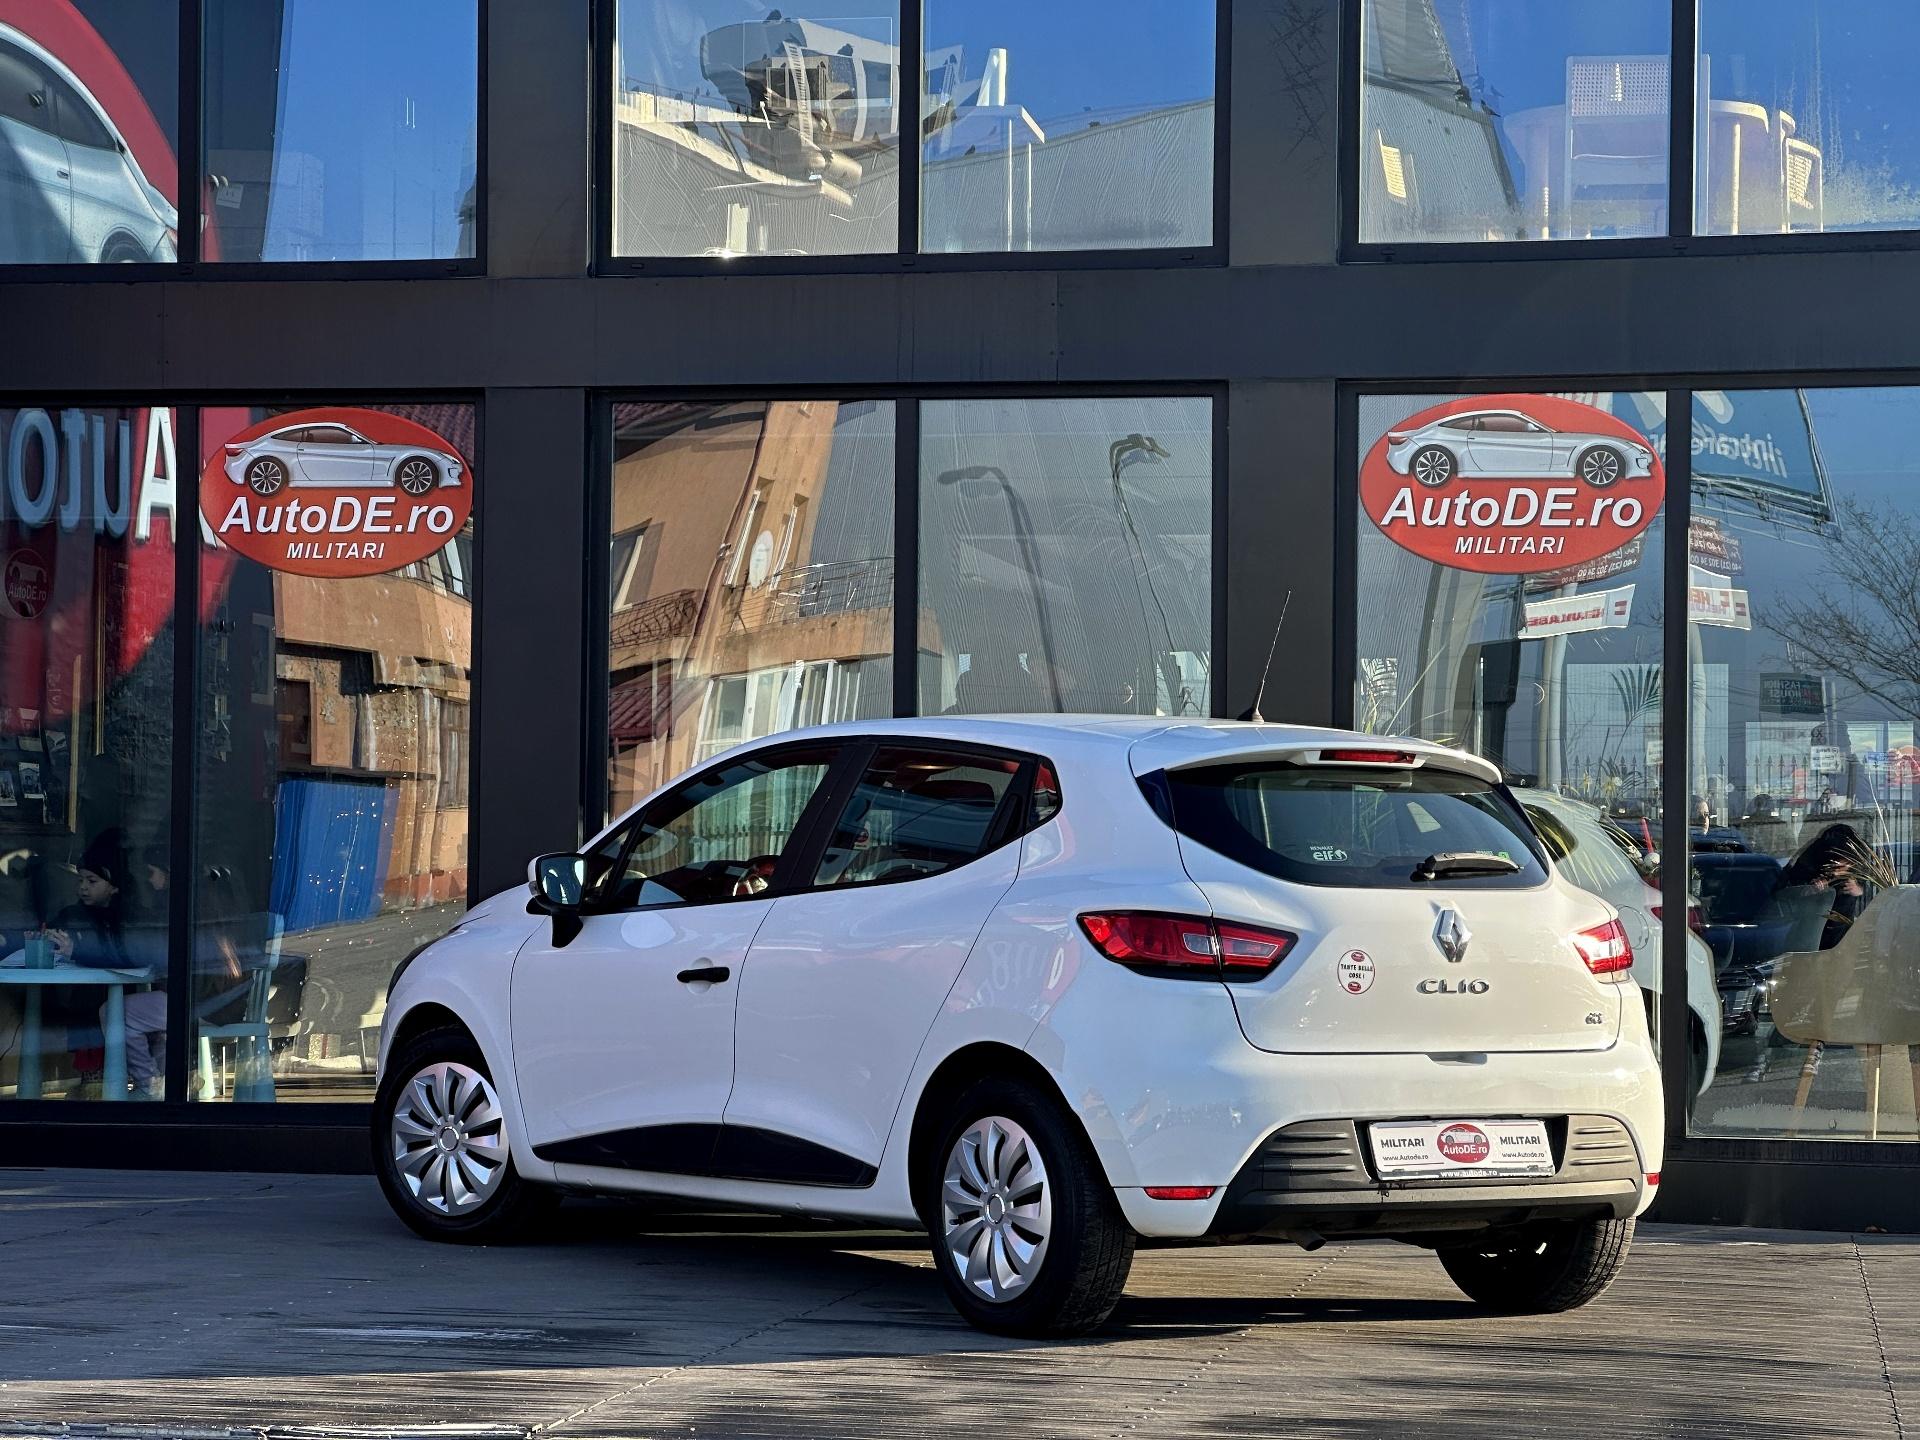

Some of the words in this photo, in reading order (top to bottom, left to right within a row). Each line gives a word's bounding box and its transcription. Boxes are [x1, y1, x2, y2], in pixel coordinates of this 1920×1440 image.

[219, 496, 454, 533] AutoDE.ro
[1380, 487, 1643, 527] AutoDE.ro
[286, 542, 385, 559] MILITARI
[1455, 536, 1565, 554] MILITARI
[1416, 979, 1490, 994] CLIO
[1381, 1138, 1425, 1148] MILITARI
[1500, 1136, 1541, 1145] MILITARI
[1443, 1144, 1488, 1155] AutoDE.ro
